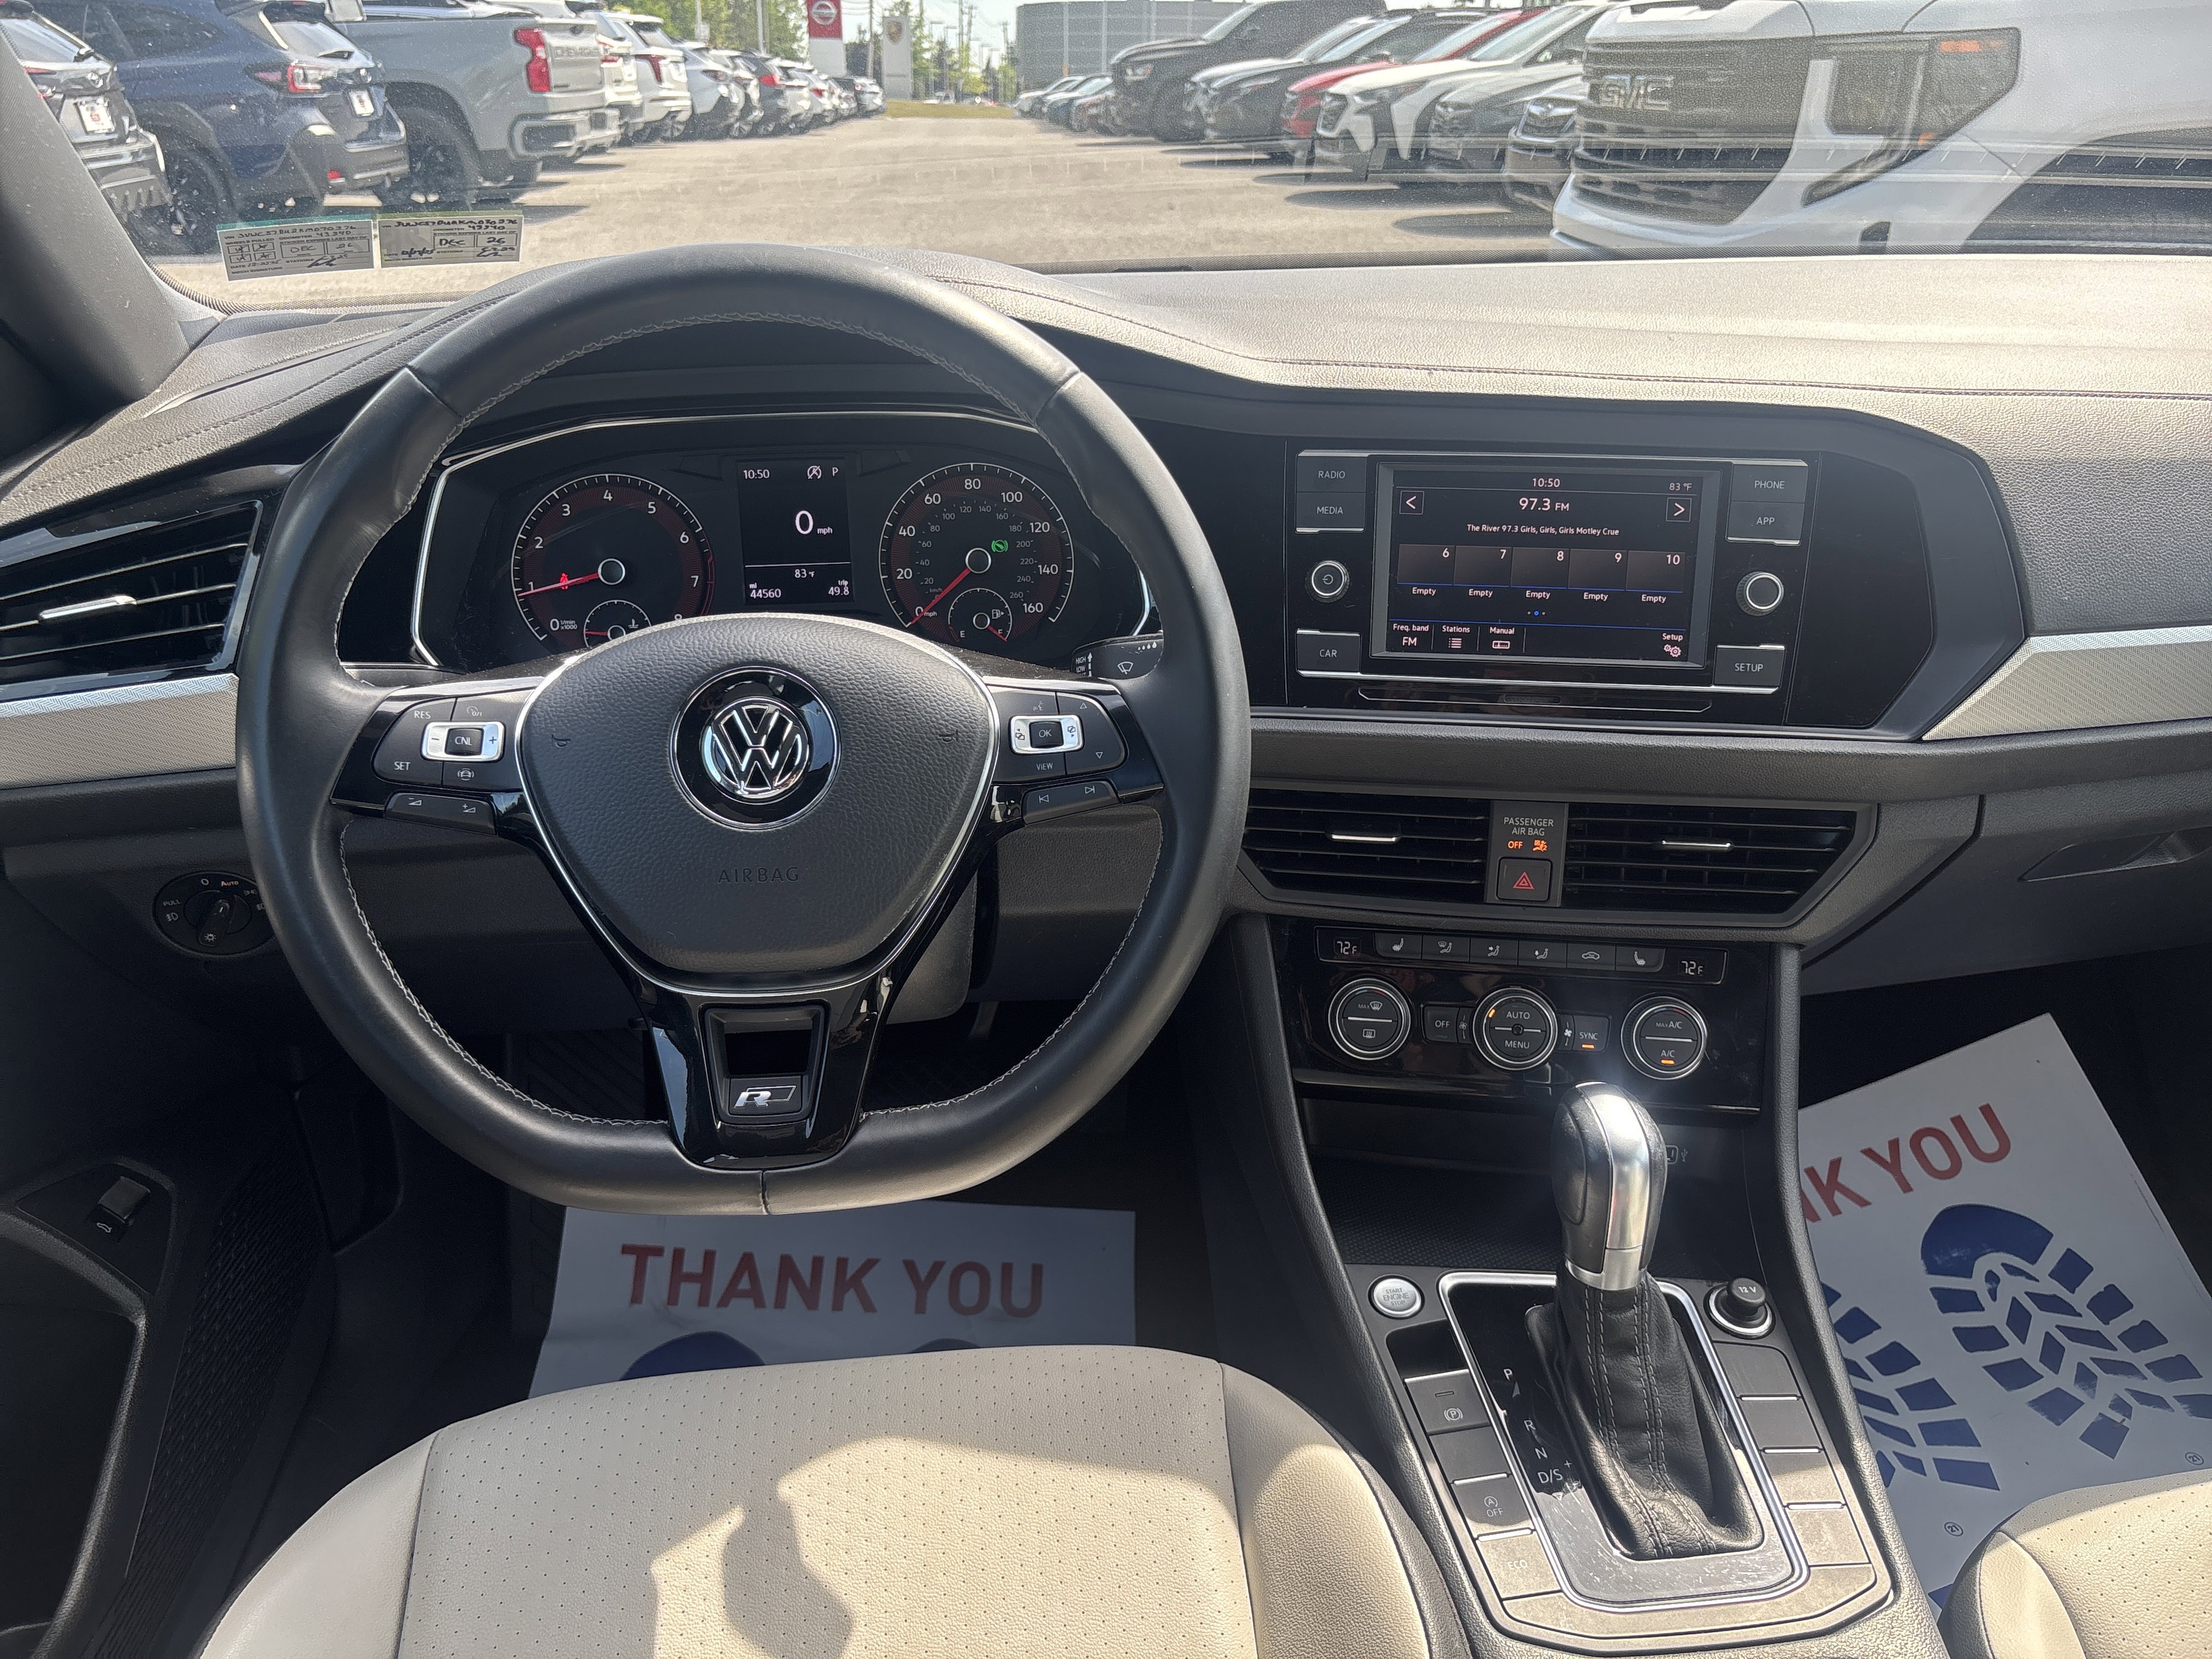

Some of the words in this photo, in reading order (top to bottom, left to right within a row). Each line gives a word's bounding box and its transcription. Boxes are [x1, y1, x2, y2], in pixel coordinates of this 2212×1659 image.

[1597, 74, 1675, 111] GMC
[743, 469, 770, 479] 10:50
[832, 467, 839, 477] P
[1318, 471, 1346, 479] RADIO
[964, 478, 981, 490] 80
[1532, 478, 1560, 488] 10:50
[1669, 482, 1680, 491] 83
[1754, 480, 1785, 489] PHONE
[603, 489, 613, 501] 4
[924, 493, 941, 505] 60
[1001, 491, 1023, 503] 100
[648, 501, 657, 514] 5
[979, 505, 992, 513] 140
[1519, 497, 1551, 511] 97.3
[1555, 503, 1570, 511] FM
[562, 504, 571, 516] 3
[960, 505, 972, 514] 120
[942, 512, 956, 521] 100
[1756, 517, 1775, 526] APP
[795, 510, 814, 534] 0
[817, 527, 833, 535] mph
[1029, 521, 1050, 533] 120
[899, 525, 916, 538] 40
[930, 524, 940, 532] 80
[1009, 524, 1022, 533] 180
[1502, 524, 1519, 533] 97.3
[1520, 525, 1538, 534] Girls,
[1539, 526, 1558, 535] Girls,
[1576, 527, 1601, 537] Motley
[680, 531, 689, 544] 6
[534, 537, 544, 549] 2
[921, 540, 932, 548] 60
[1016, 540, 1031, 548] 200
[1442, 548, 1450, 558] 6
[1500, 549, 1506, 560] 7
[1556, 550, 1564, 561] 8
[1615, 552, 1622, 563] 9
[919, 558, 930, 567] 40
[1020, 557, 1034, 566] 220
[1666, 554, 1680, 565] 10
[794, 568, 807, 578] 83
[896, 568, 912, 580] 20
[1037, 563, 1058, 575] 140
[691, 575, 699, 588] 7
[1017, 575, 1031, 583] 240
[750, 588, 782, 599] 44560
[828, 586, 850, 596] 49.8
[1412, 586, 1436, 596] Empty
[1469, 588, 1493, 598] Empty
[1526, 590, 1550, 600] Empty
[1583, 592, 1609, 602] Empty
[1641, 594, 1667, 603] Empty
[1023, 602, 1043, 613] 160
[550, 618, 560, 631] 0
[1393, 623, 1410, 633] Freq.
[1442, 625, 1470, 633] Stations
[1489, 627, 1515, 635] Manual
[1402, 636, 1418, 646] FM
[1662, 633, 1683, 642] Setup
[1319, 649, 1338, 658] CAR
[1075, 656, 1086, 664] HIGH
[1076, 664, 1086, 673] LOW
[1734, 663, 1764, 672] SETUP
[414, 710, 431, 719] RES
[1039, 729, 1052, 738] OK
[455, 736, 472, 746] CNL
[394, 761, 411, 771] SET
[1036, 762, 1053, 771] VIEW
[1504, 817, 1554, 827] PASSENGER
[1528, 828, 1545, 836] BAG
[1508, 840, 1523, 849] OFF
[718, 867, 800, 884] AIRBAG
[1506, 1011, 1531, 1019] AUTO
[1435, 1020, 1450, 1028] OFF
[1668, 1020, 1683, 1029] A/C
[1579, 1031, 1598, 1040] SYNC
[1505, 1040, 1530, 1049] MENU
[1661, 1049, 1675, 1058] A/C
[733, 1091, 772, 1109] R
[1860, 1103, 2012, 1194] YOU
[620, 1243, 881, 1313] THANK
[902, 1259, 1045, 1317] YOU
[1383, 1293, 1409, 1301] ENGINE
[1503, 1368, 1513, 1381] P
[1523, 1420, 1536, 1431] R
[1534, 1447, 1548, 1459] N
[1537, 1468, 1563, 1484] D/S
[1486, 1508, 1504, 1517] OFF
[1508, 1559, 1528, 1570] ECO
